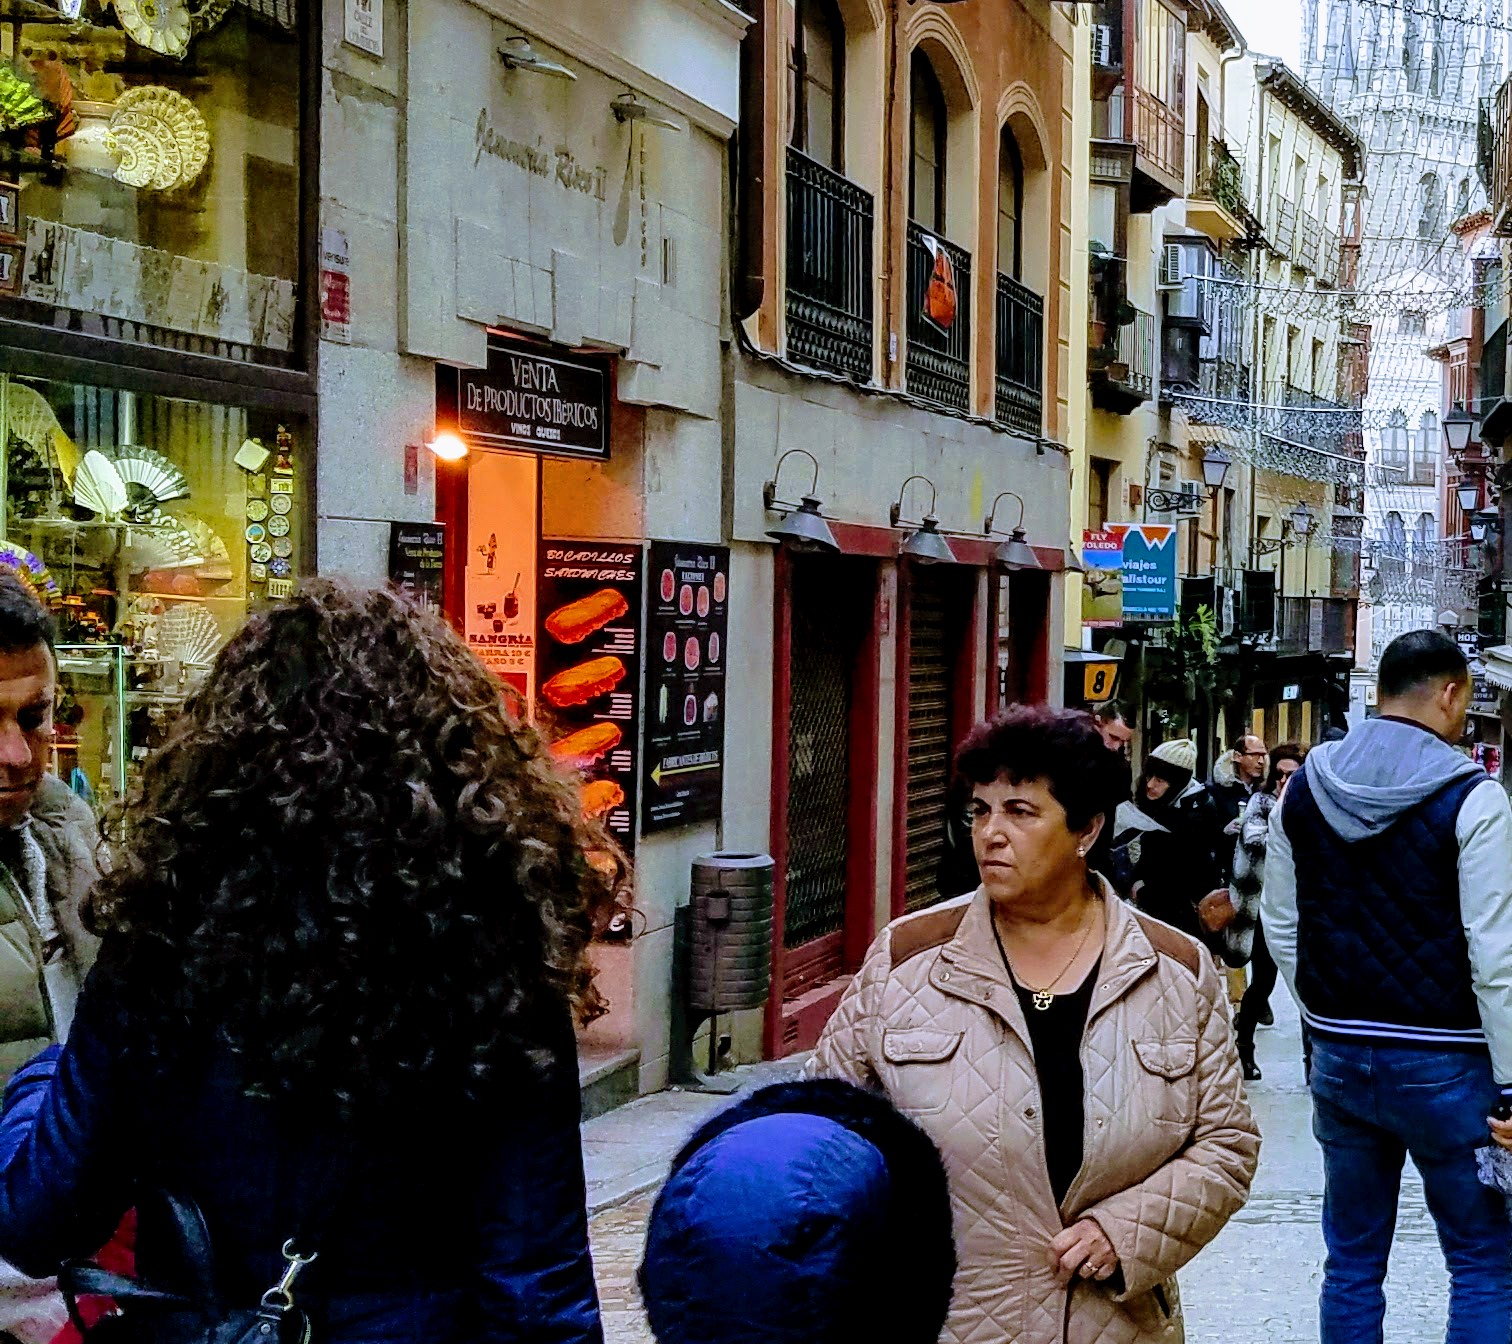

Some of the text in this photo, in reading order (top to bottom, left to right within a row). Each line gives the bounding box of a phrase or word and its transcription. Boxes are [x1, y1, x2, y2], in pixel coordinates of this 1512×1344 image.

[510, 357, 560, 393] VENTA
[467, 383, 482, 411] DE
[483, 385, 551, 423] PRODUCTOS
[1090, 533, 1108, 541] FLY
[546, 549, 634, 564] BOCADILLOS
[1122, 560, 1157, 571] viajes
[544, 567, 636, 581] SANDWICHES
[469, 633, 533, 645] SANGRÍA
[1093, 670, 1106, 694] 8
